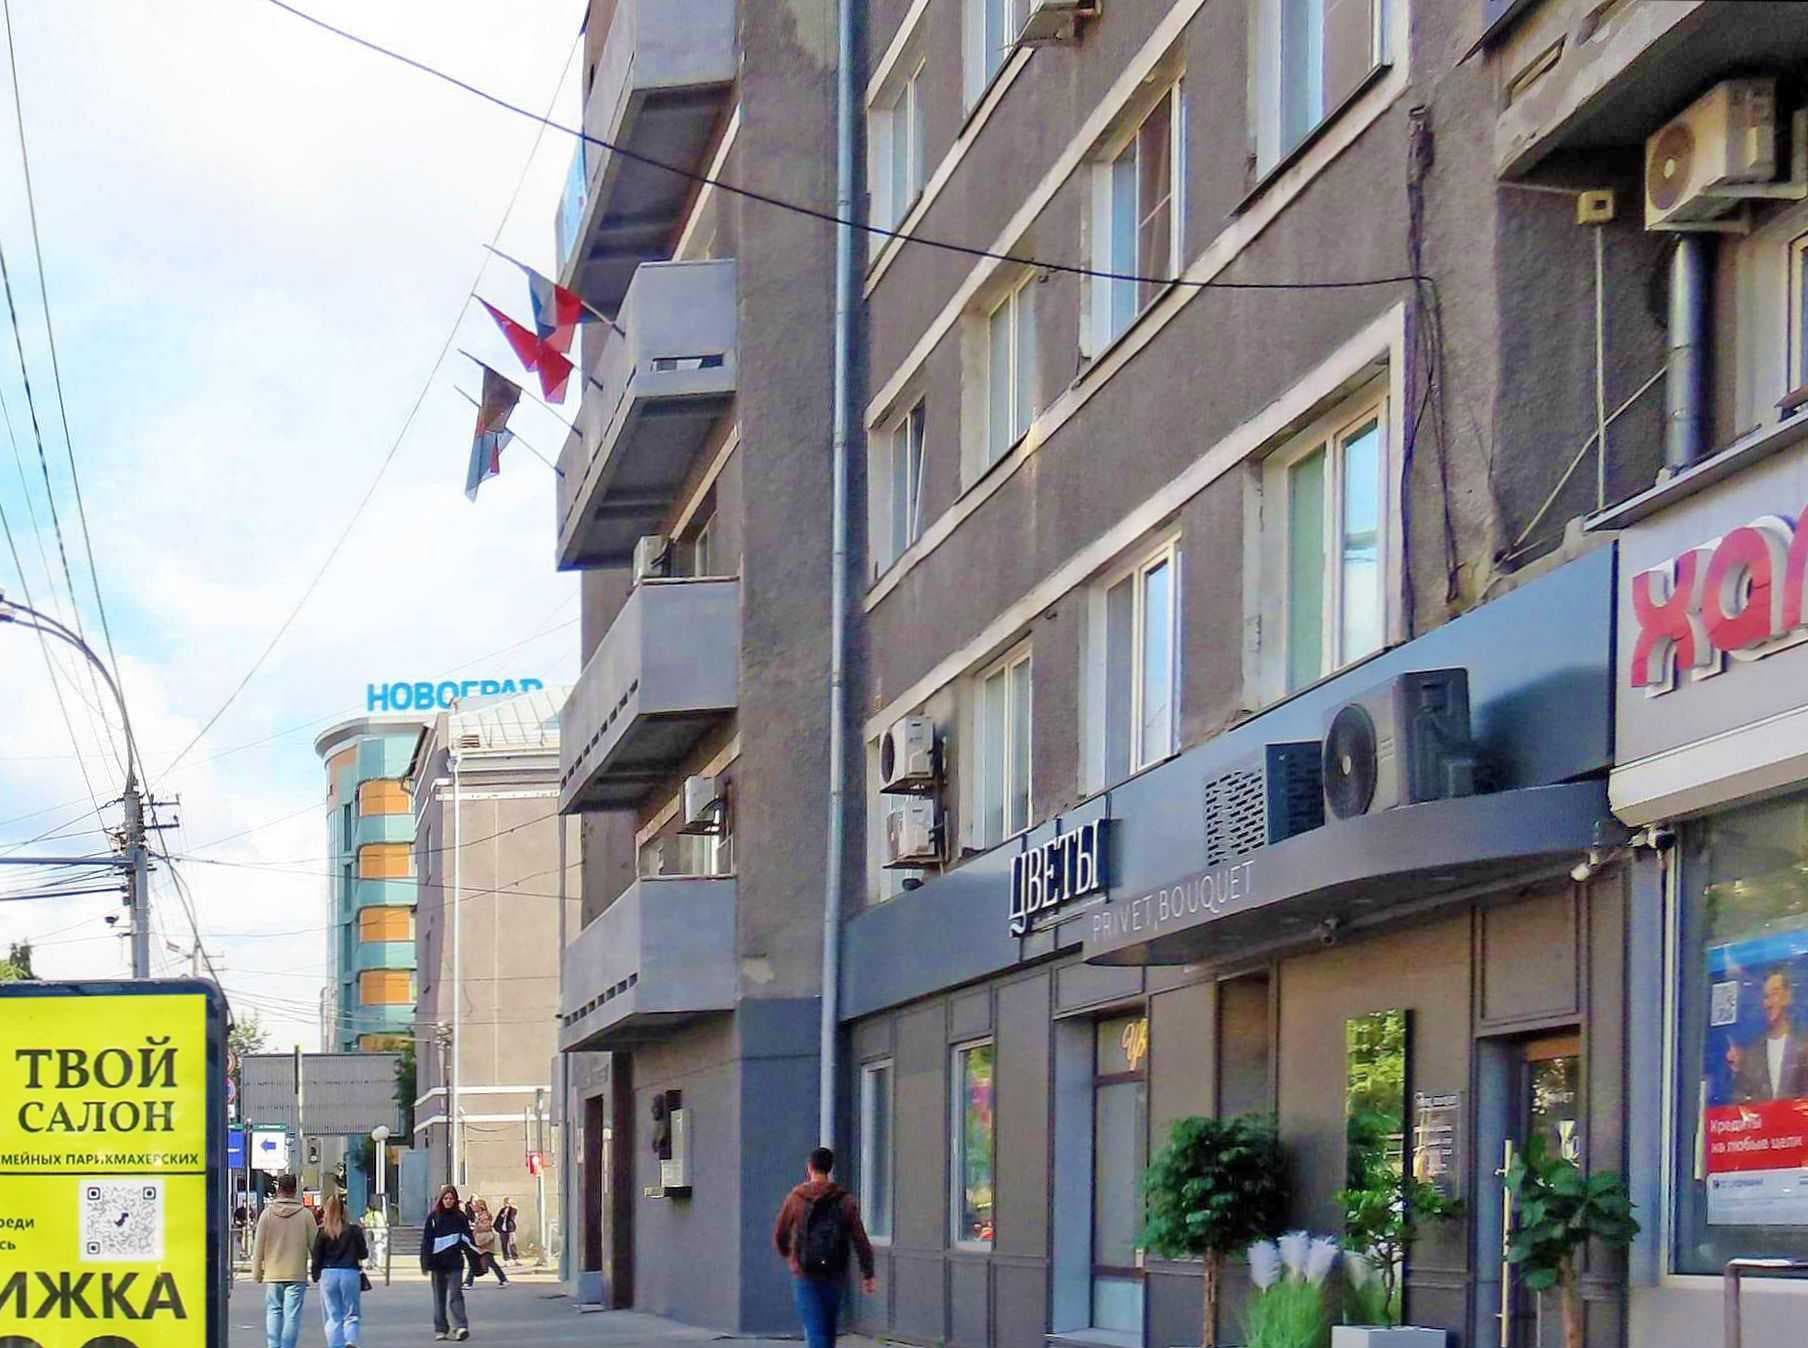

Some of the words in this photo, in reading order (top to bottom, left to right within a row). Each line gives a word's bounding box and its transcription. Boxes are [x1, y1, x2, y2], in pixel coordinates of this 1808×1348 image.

[1009, 818, 1101, 934] ЦВЕТЫ
[15, 1036, 178, 1089] ТВОЙ
[18, 1101, 175, 1132] САЛОН
